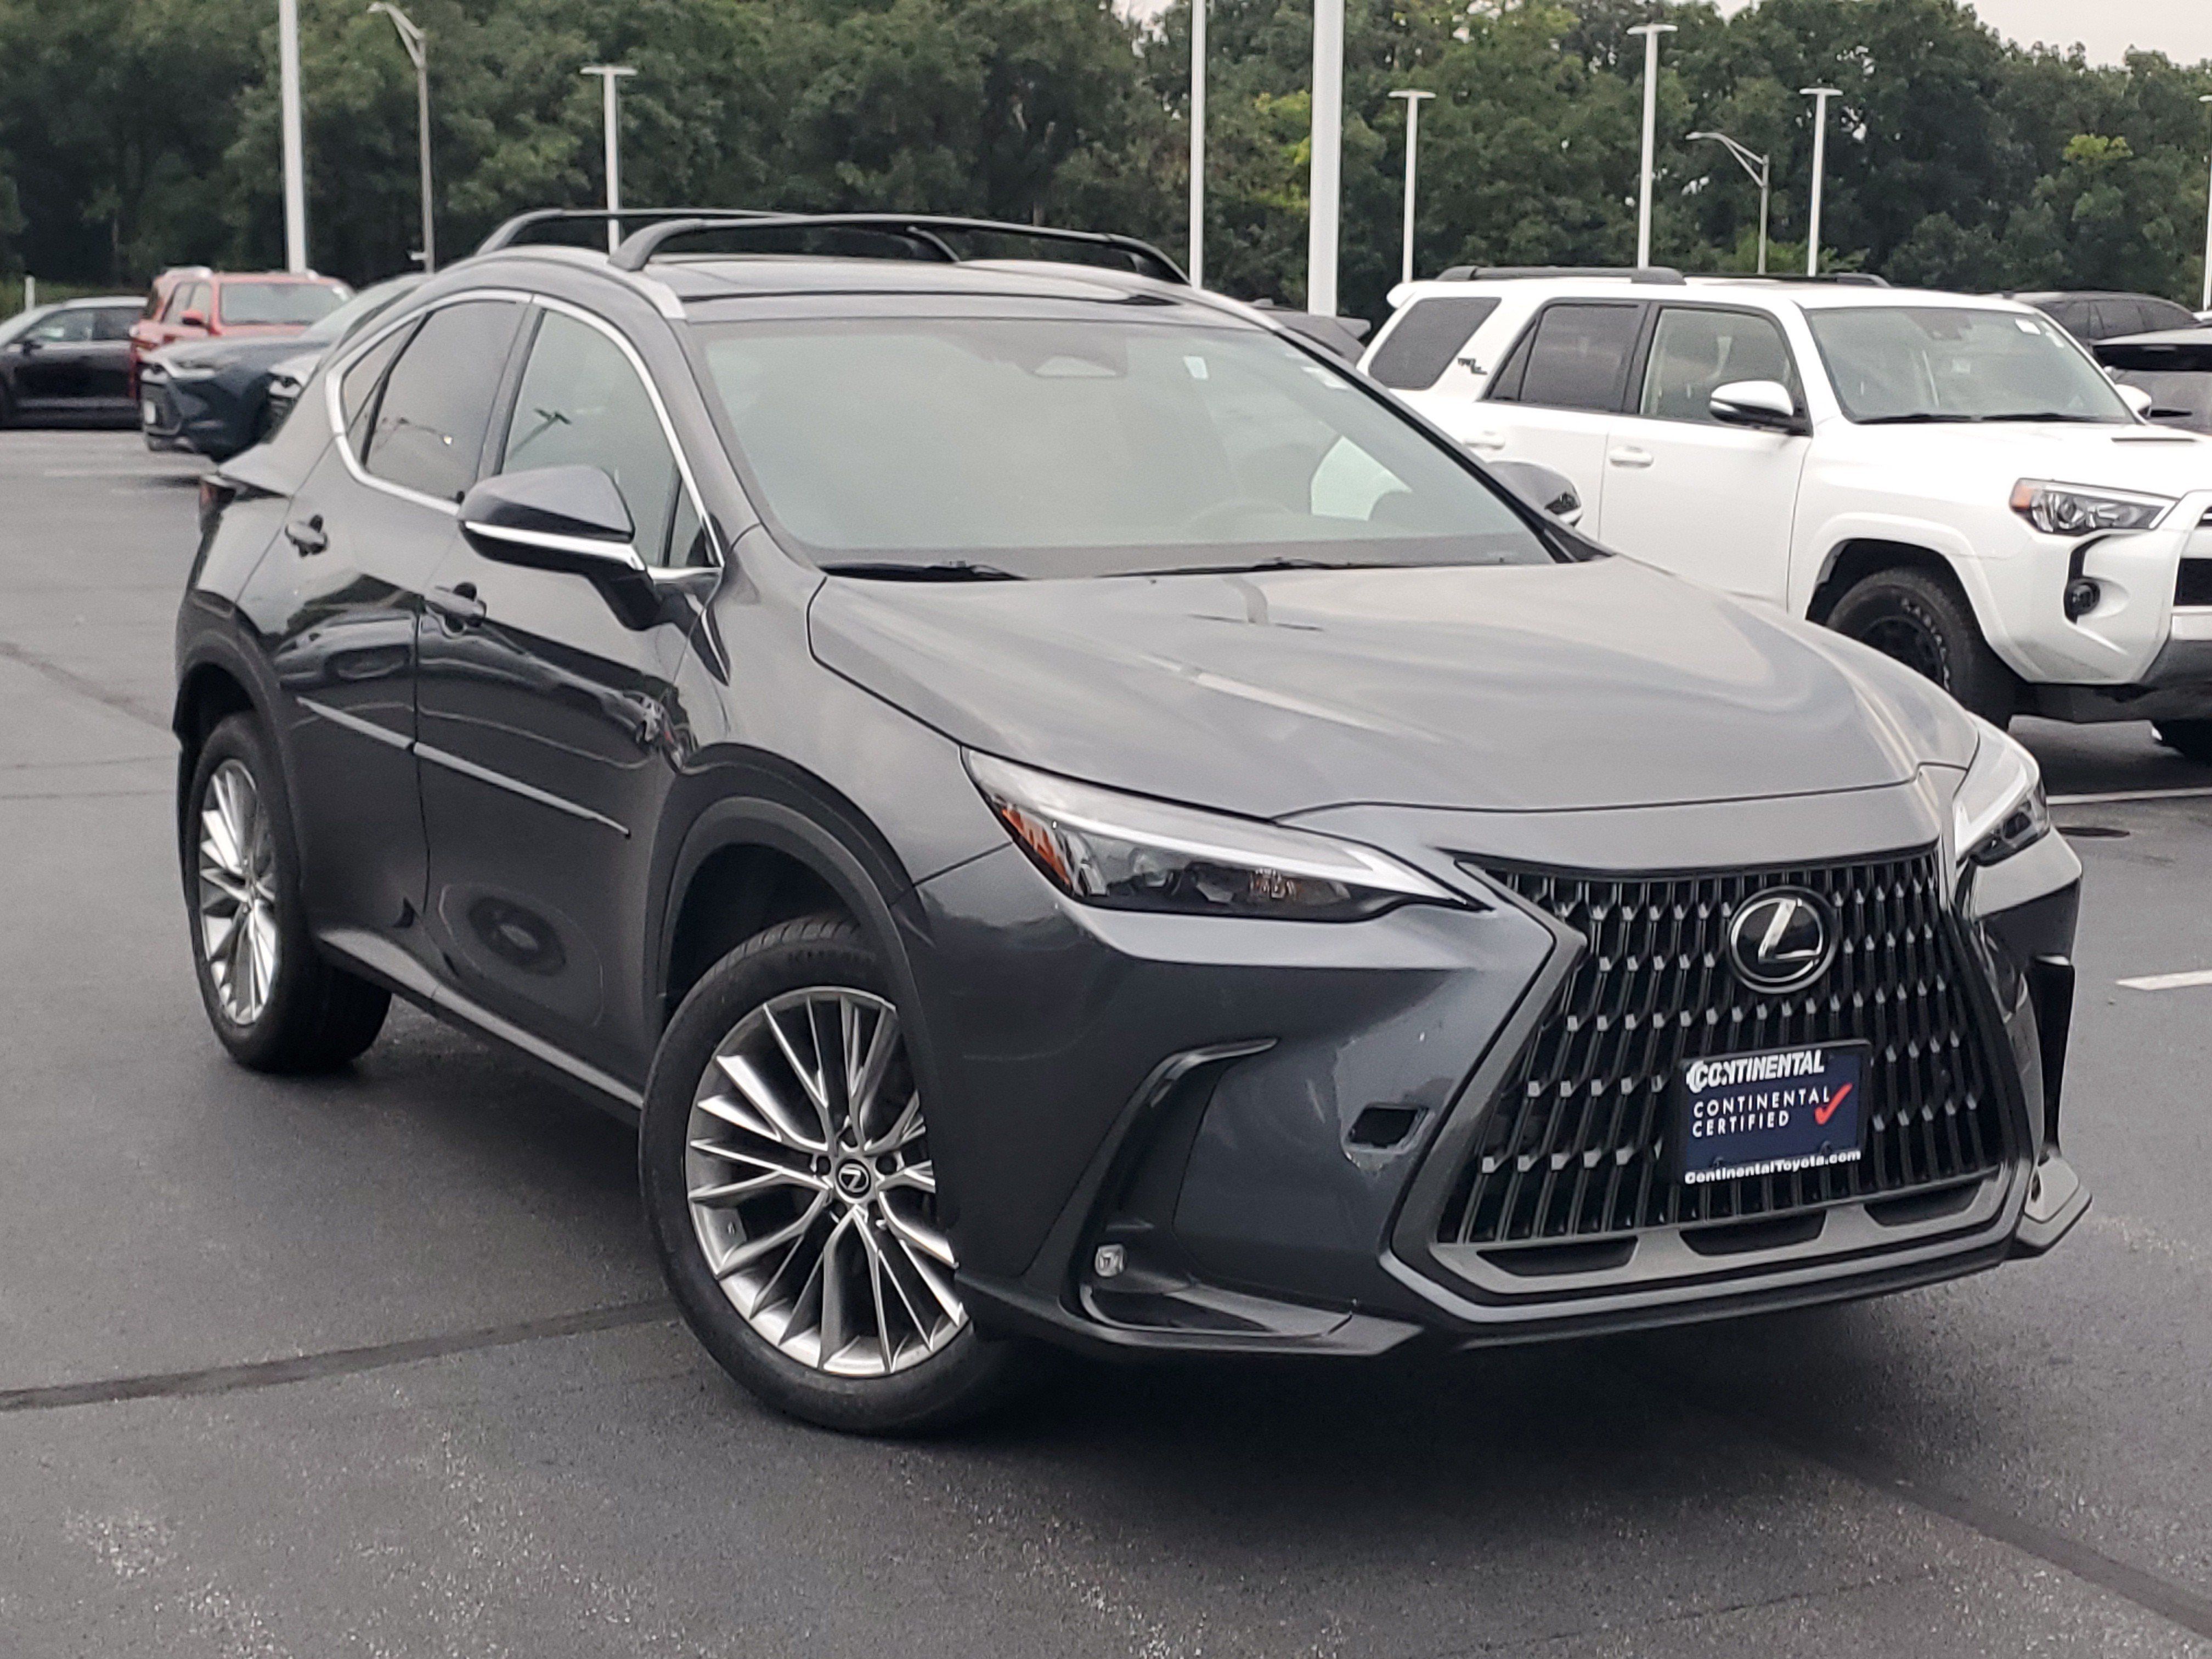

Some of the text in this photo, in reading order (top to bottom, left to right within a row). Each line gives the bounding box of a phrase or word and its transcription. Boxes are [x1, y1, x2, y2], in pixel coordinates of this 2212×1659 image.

[1686, 1049, 1825, 1093] CONTINENTAL
[1693, 1085, 1830, 1118] CONTINENTAL
[1692, 1110, 1790, 1138] CERTIFIED
[1684, 1149, 1862, 1185] ContinentalToyota.com
